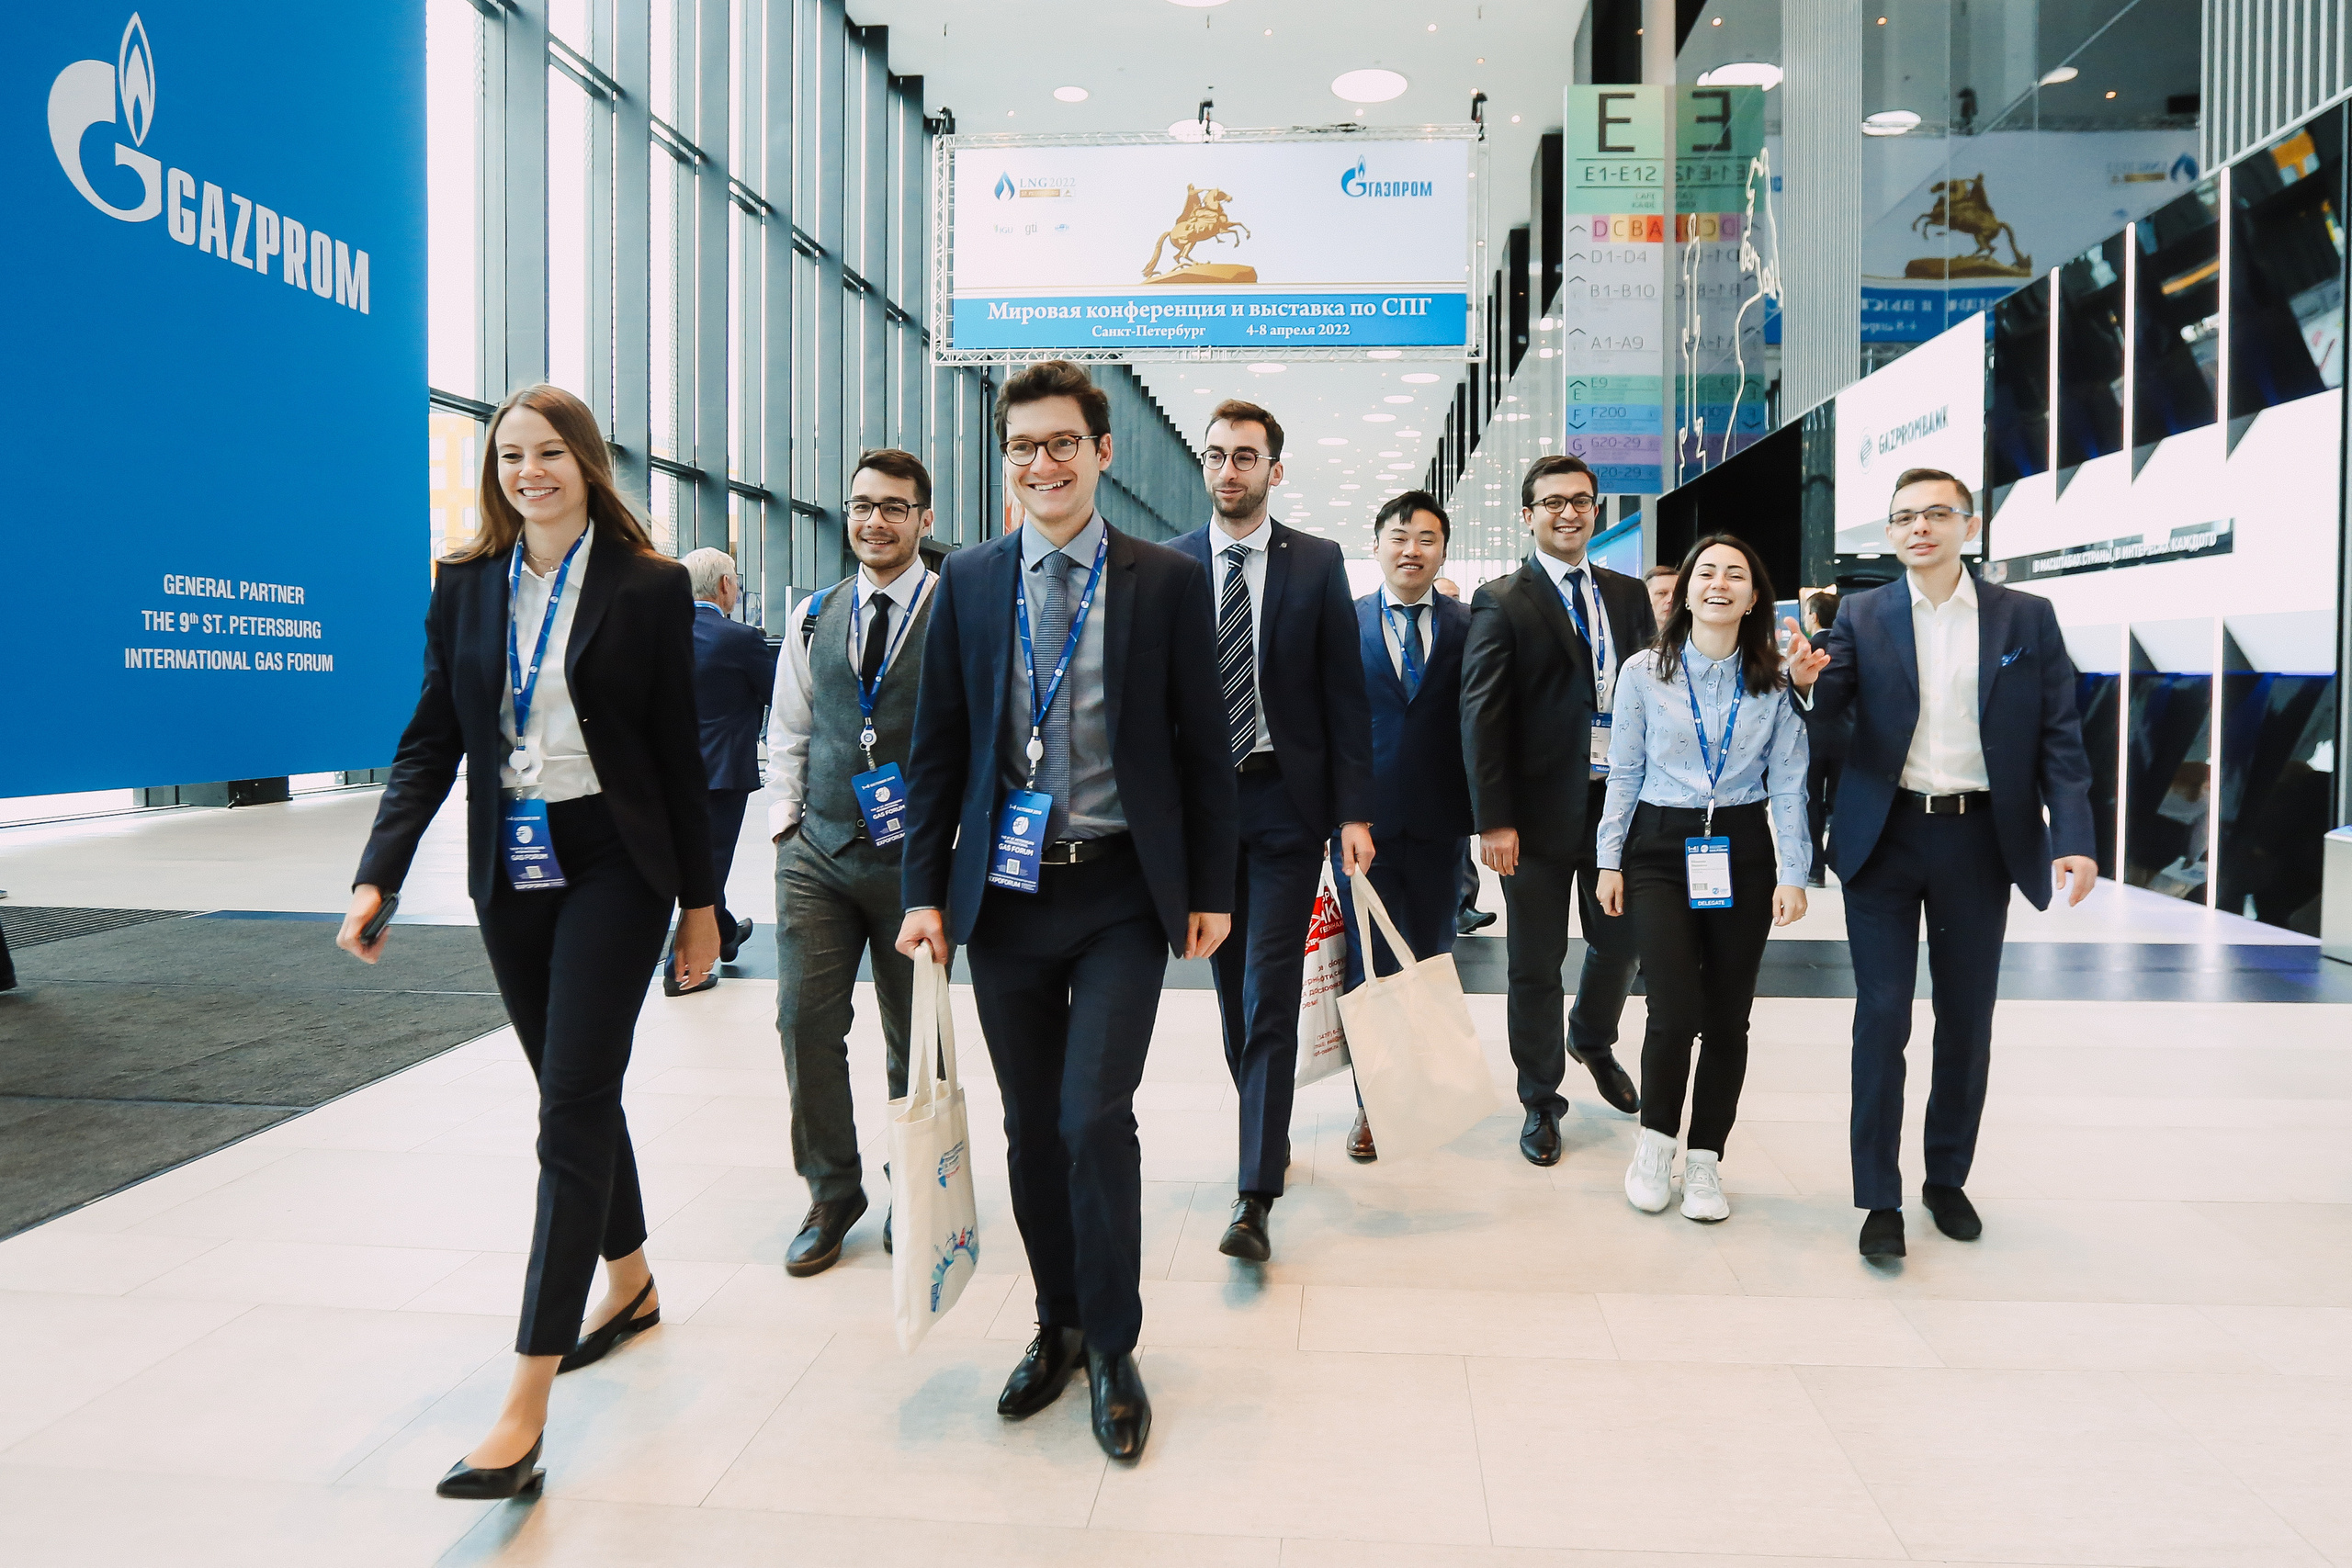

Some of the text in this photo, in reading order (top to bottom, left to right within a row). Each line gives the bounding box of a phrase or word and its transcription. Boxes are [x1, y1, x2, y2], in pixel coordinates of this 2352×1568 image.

[1598, 92, 1636, 152] E
[1585, 165, 1657, 182] E1-E12
[1368, 181, 1432, 197] ГАЗПРОМ
[167, 166, 369, 315] GAZPROM
[1591, 249, 1647, 264] D1-D4
[1590, 283, 1656, 299] B1-B10
[987, 297, 1432, 325] Мировая конференция и выставка по СПГ
[1091, 323, 1206, 340] Санкт-Петербург
[1246, 323, 1351, 339] 4-8 апреля 2022
[1591, 335, 1645, 350] A1-A9
[1574, 408, 1581, 421] F
[1591, 406, 1627, 418] F200
[1878, 403, 1950, 456] GAZPROMBANK
[1572, 438, 1583, 451] G
[1591, 436, 1641, 448] G20-29
[163, 573, 305, 604] GENERAL PARTNER
[141, 610, 322, 639] THE 9th ST. PETERSBURG
[124, 648, 334, 671] INTERNATIONAL GAS FORUM
[998, 842, 1035, 857] GAS FORUM
